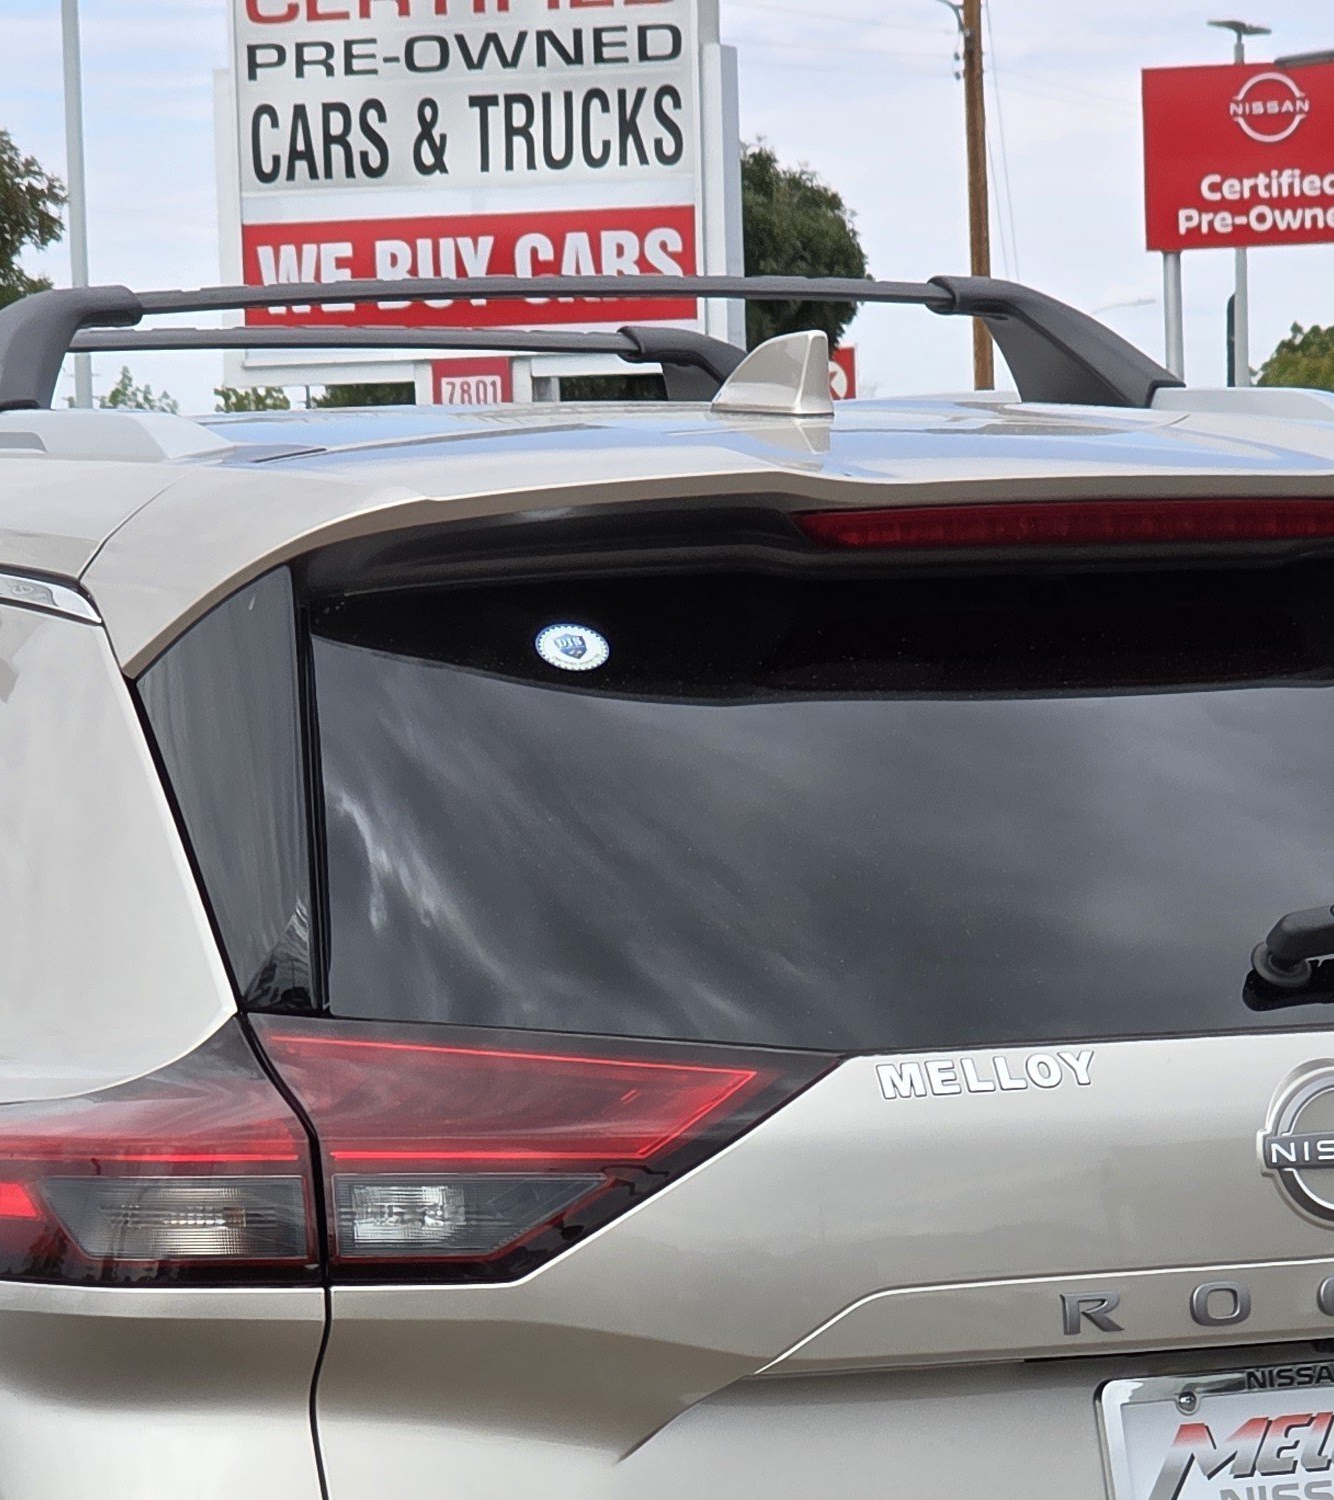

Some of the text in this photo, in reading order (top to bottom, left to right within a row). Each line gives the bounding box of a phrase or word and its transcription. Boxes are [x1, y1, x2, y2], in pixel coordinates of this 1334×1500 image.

[247, 24, 683, 81] PRE-OWNED
[251, 84, 684, 184] CARS & TRUCKS
[1229, 99, 1310, 117] NISSAN
[257, 227, 684, 315] WE BUY CARS
[445, 379, 498, 405] 7801
[875, 1050, 1095, 1100] MELLOY
